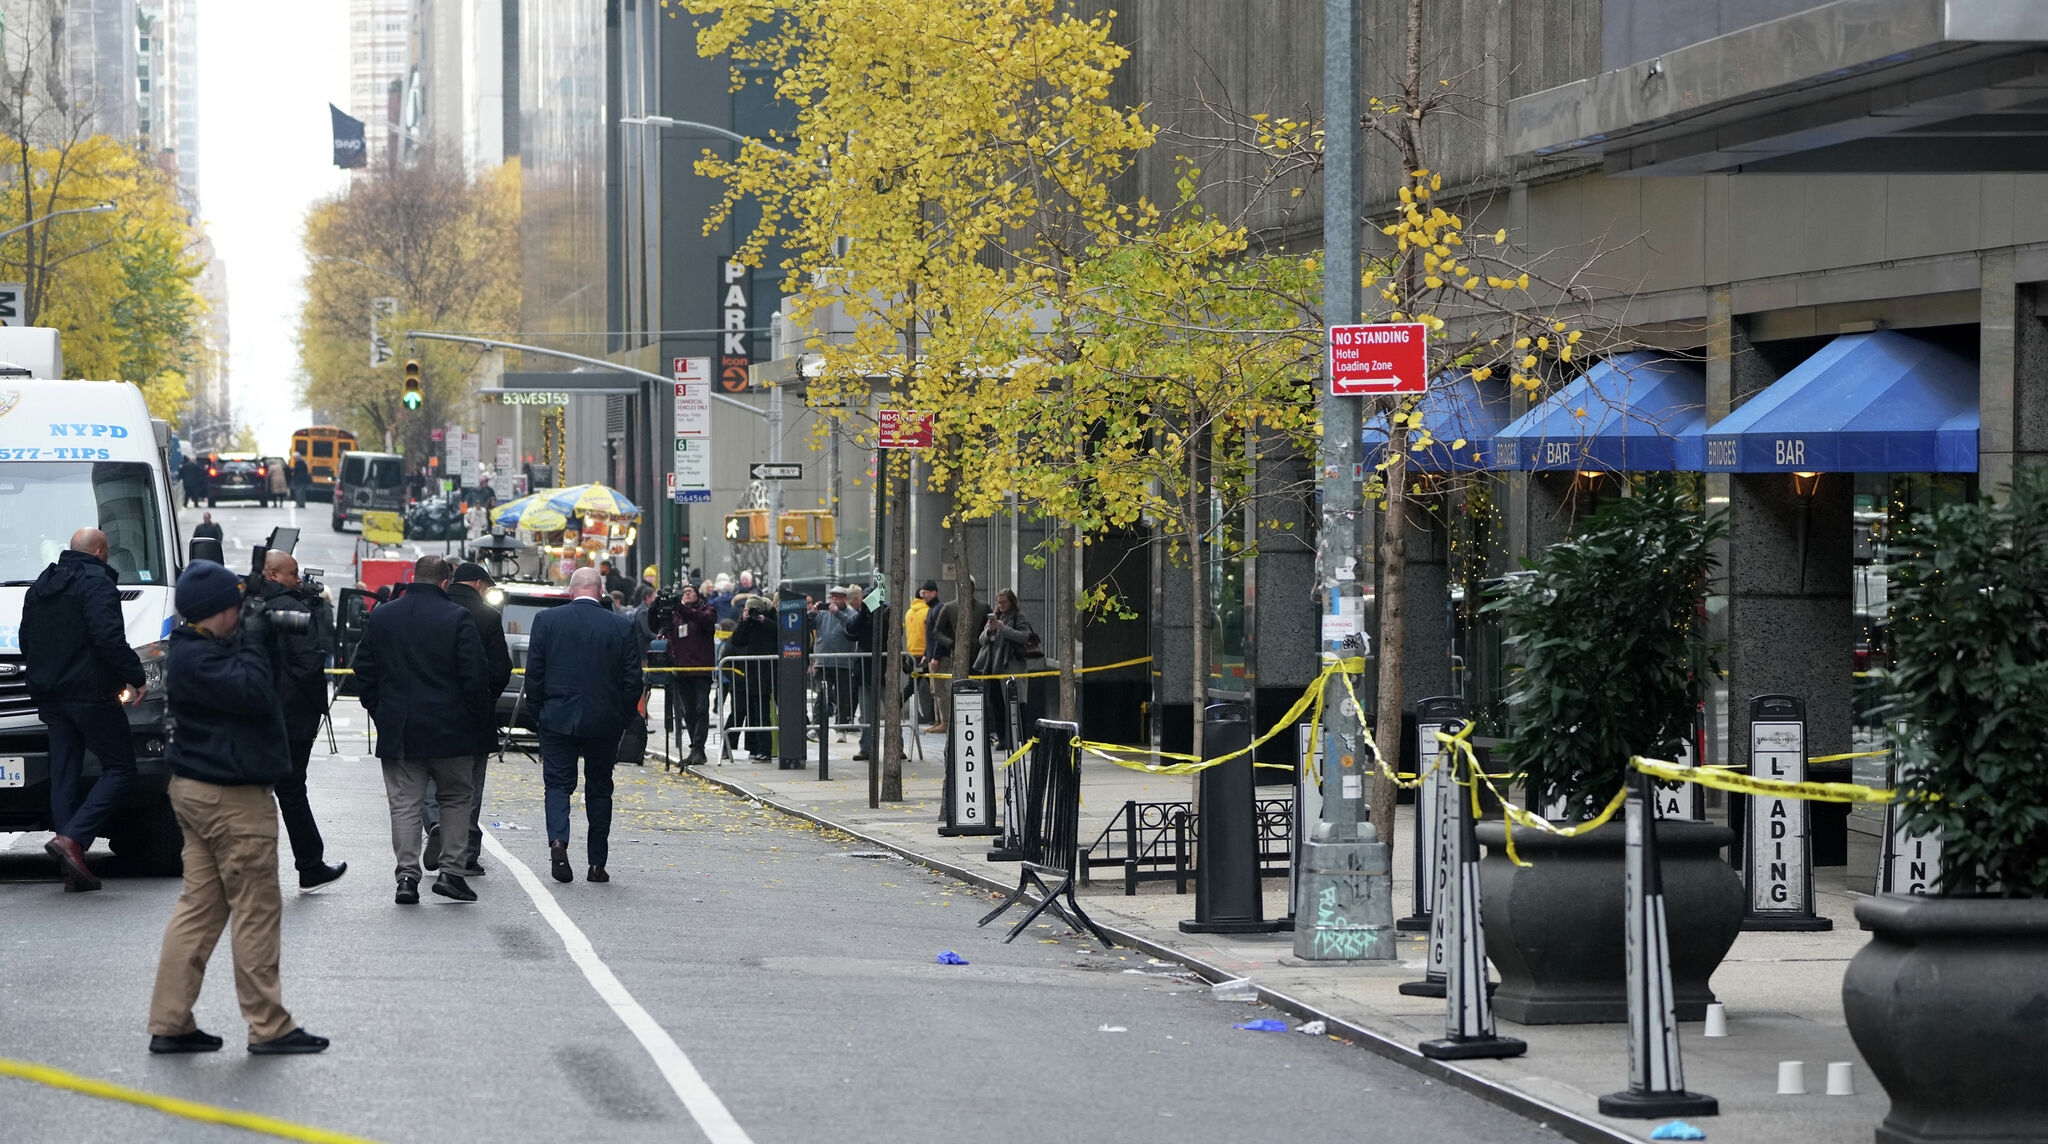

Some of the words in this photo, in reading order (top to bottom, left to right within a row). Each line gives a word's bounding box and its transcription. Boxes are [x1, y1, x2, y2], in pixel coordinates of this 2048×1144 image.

[724, 261, 747, 355] PARK
[1336, 332, 1352, 345] NO
[1354, 331, 1410, 344] STANDING
[722, 356, 748, 366] icon
[1336, 349, 1360, 359] Hotel
[1336, 361, 1370, 373] Loading
[1371, 360, 1393, 371] Zone
[677, 384, 684, 396] 3
[49, 424, 128, 439] NYPD
[677, 440, 685, 450] 6
[1708, 440, 1737, 465] BRIDGES
[1775, 439, 1805, 465] BAR
[1547, 442, 1570, 464] BAR
[788, 612, 799, 629] P
[964, 714, 976, 819] LOADING
[1770, 757, 1787, 903] LADING
